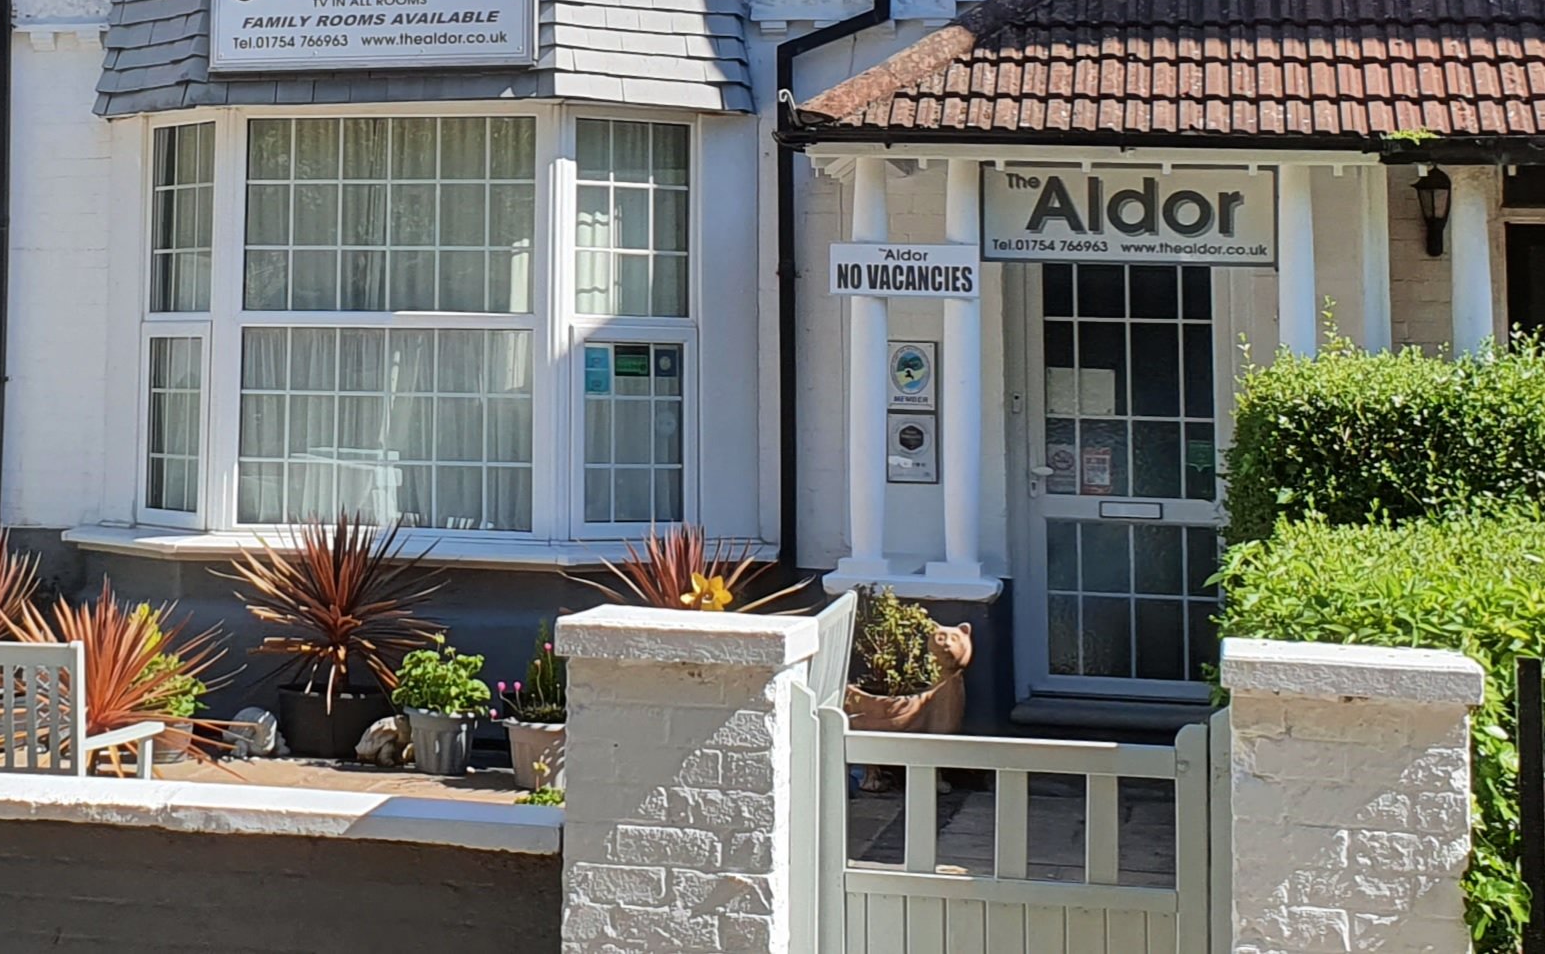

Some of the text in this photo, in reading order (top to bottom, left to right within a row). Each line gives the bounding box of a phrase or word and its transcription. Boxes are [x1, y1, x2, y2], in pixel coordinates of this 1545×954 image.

[242, 10, 500, 29] FAMILY ROOMS AVAILABLE
[233, 31, 507, 49] Tel.01754 766963 www.thealdor.co.uk
[1006, 173, 1245, 237] The Aldor
[884, 249, 928, 262] Aldor
[992, 238, 1267, 256] Tel.01754 766963 www.thealdor.co.uk
[837, 263, 973, 293] NO VACANCIES
